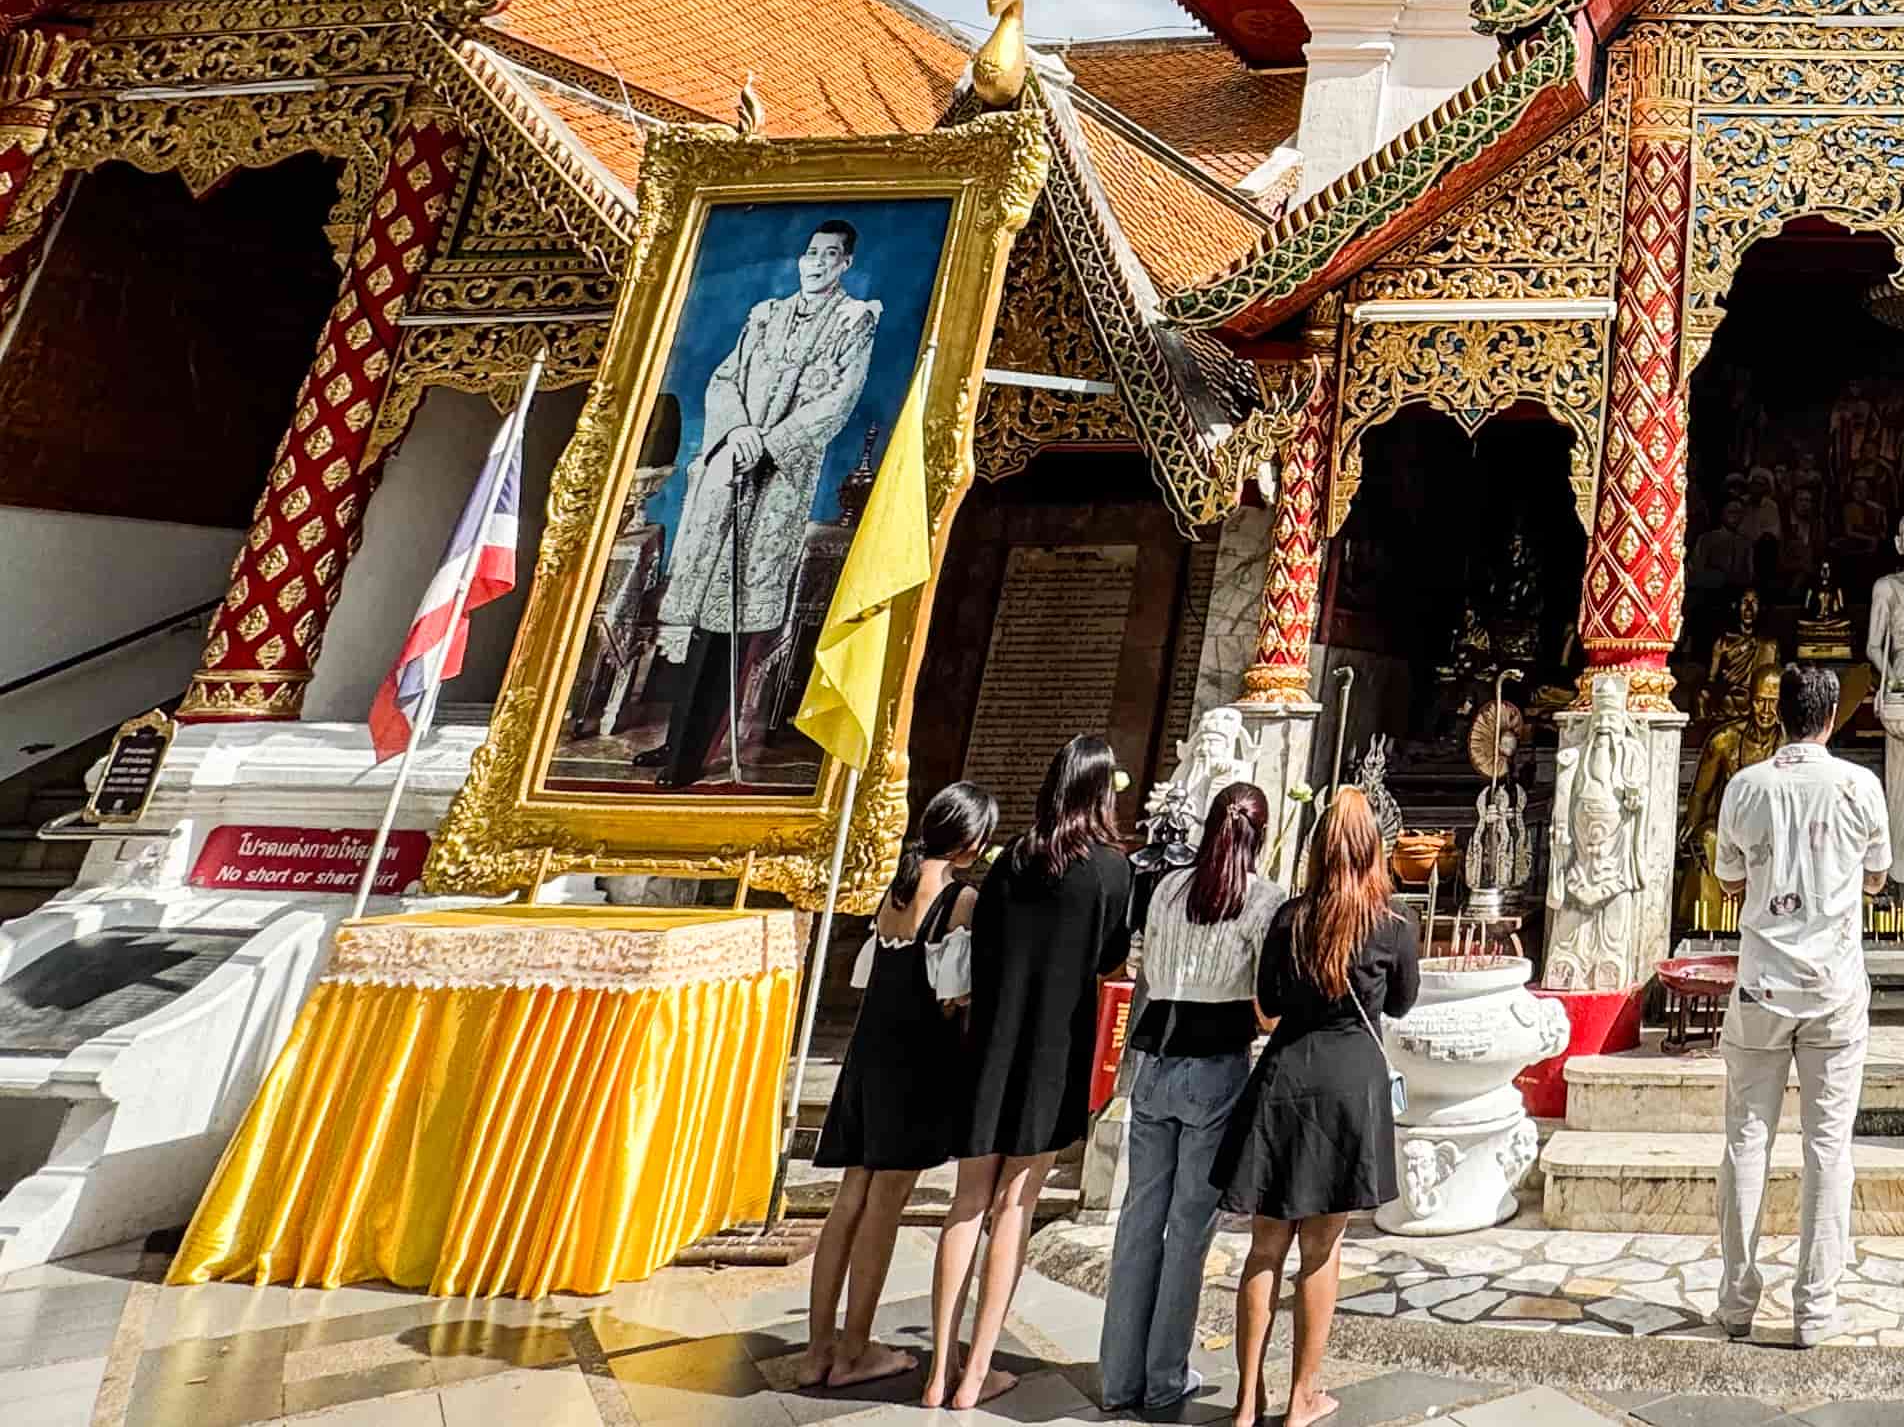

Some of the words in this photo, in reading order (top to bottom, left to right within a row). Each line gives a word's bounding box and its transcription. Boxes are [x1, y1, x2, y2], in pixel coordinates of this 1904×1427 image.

[215, 865, 242, 882] No
[245, 866, 291, 884] short
[293, 871, 312, 884] or
